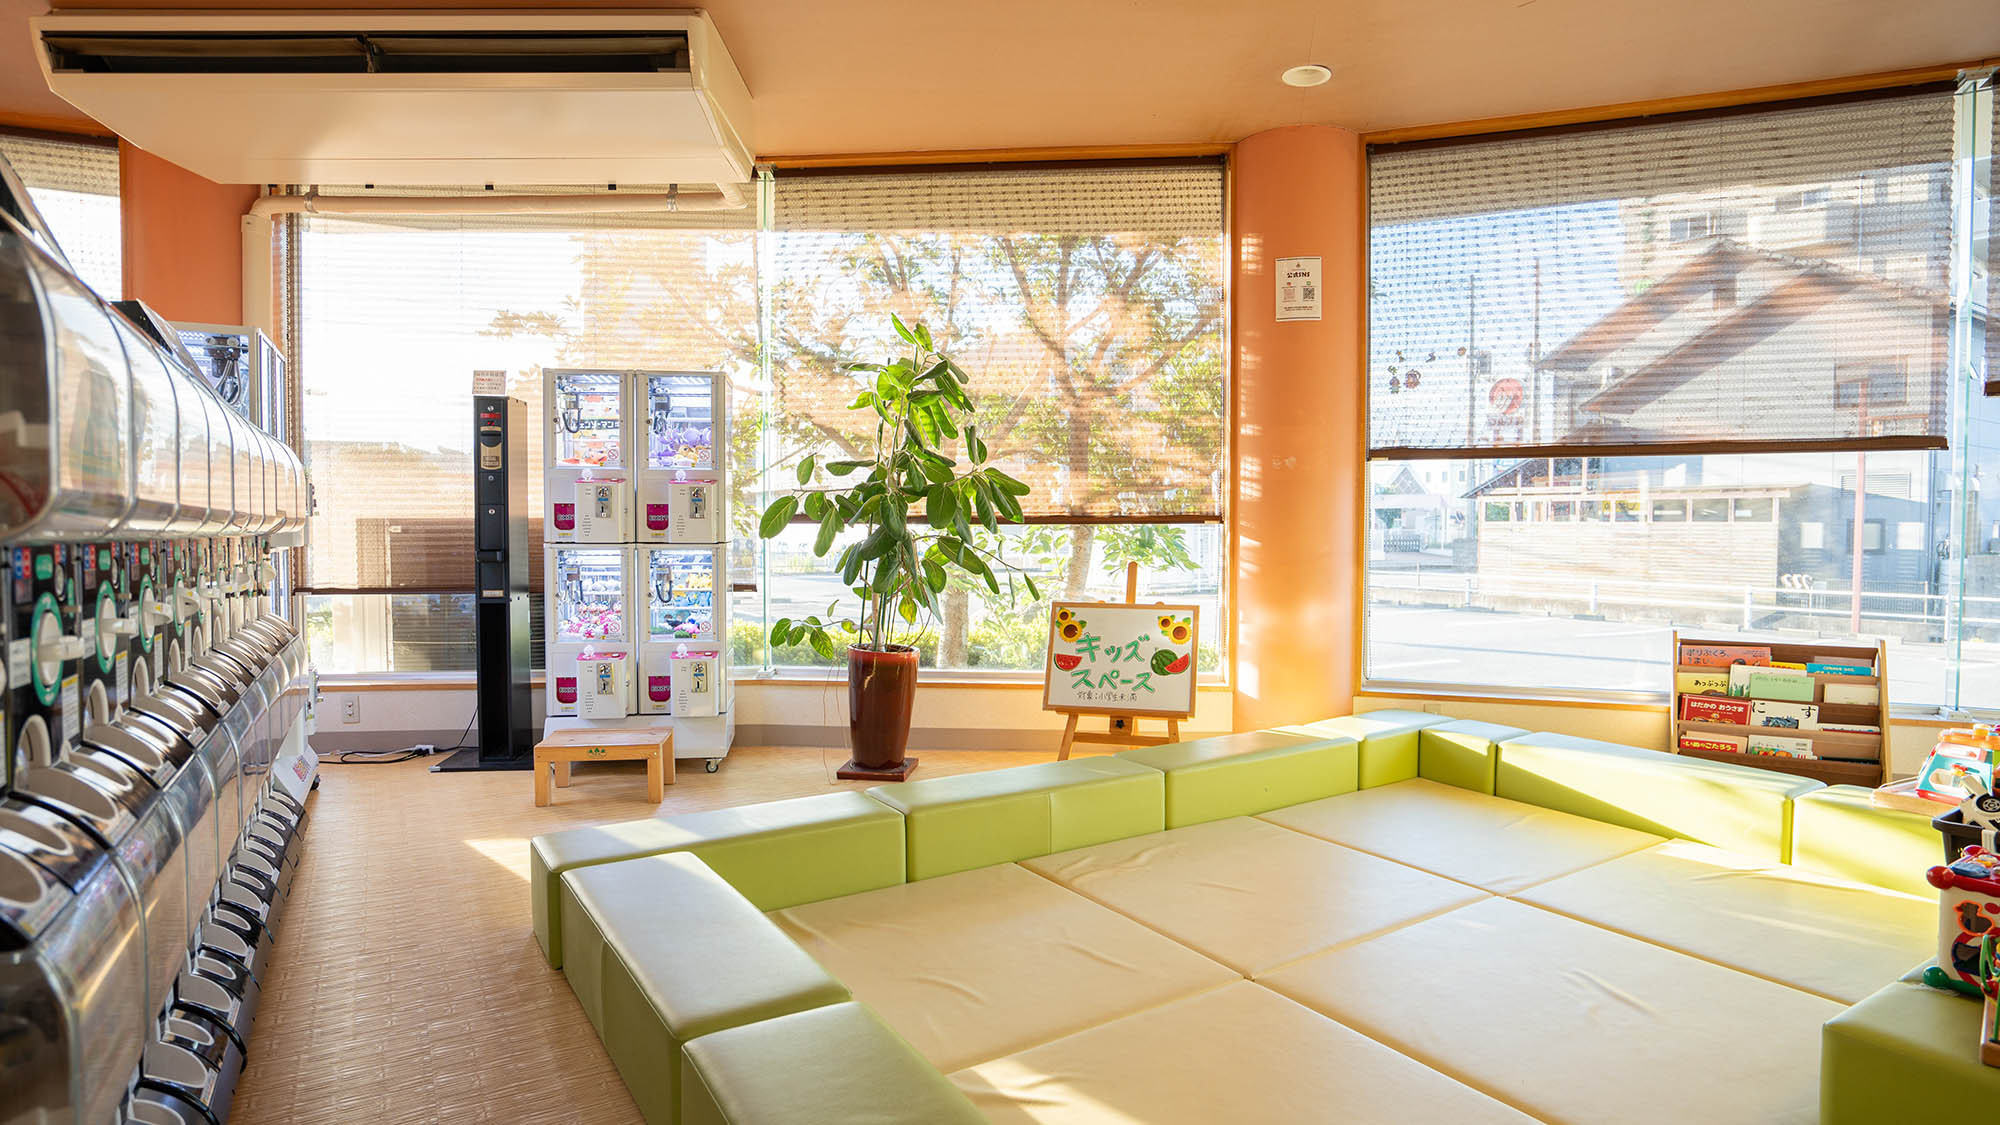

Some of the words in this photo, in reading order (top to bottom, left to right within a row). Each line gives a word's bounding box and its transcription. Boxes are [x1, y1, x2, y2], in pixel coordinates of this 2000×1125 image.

[1075, 633, 1150, 663] キッズ
[1071, 669, 1156, 694] スペース
[1690, 701, 1717, 710] はだかの
[1718, 704, 1744, 713] おうさま
[1801, 706, 1816, 719] す
